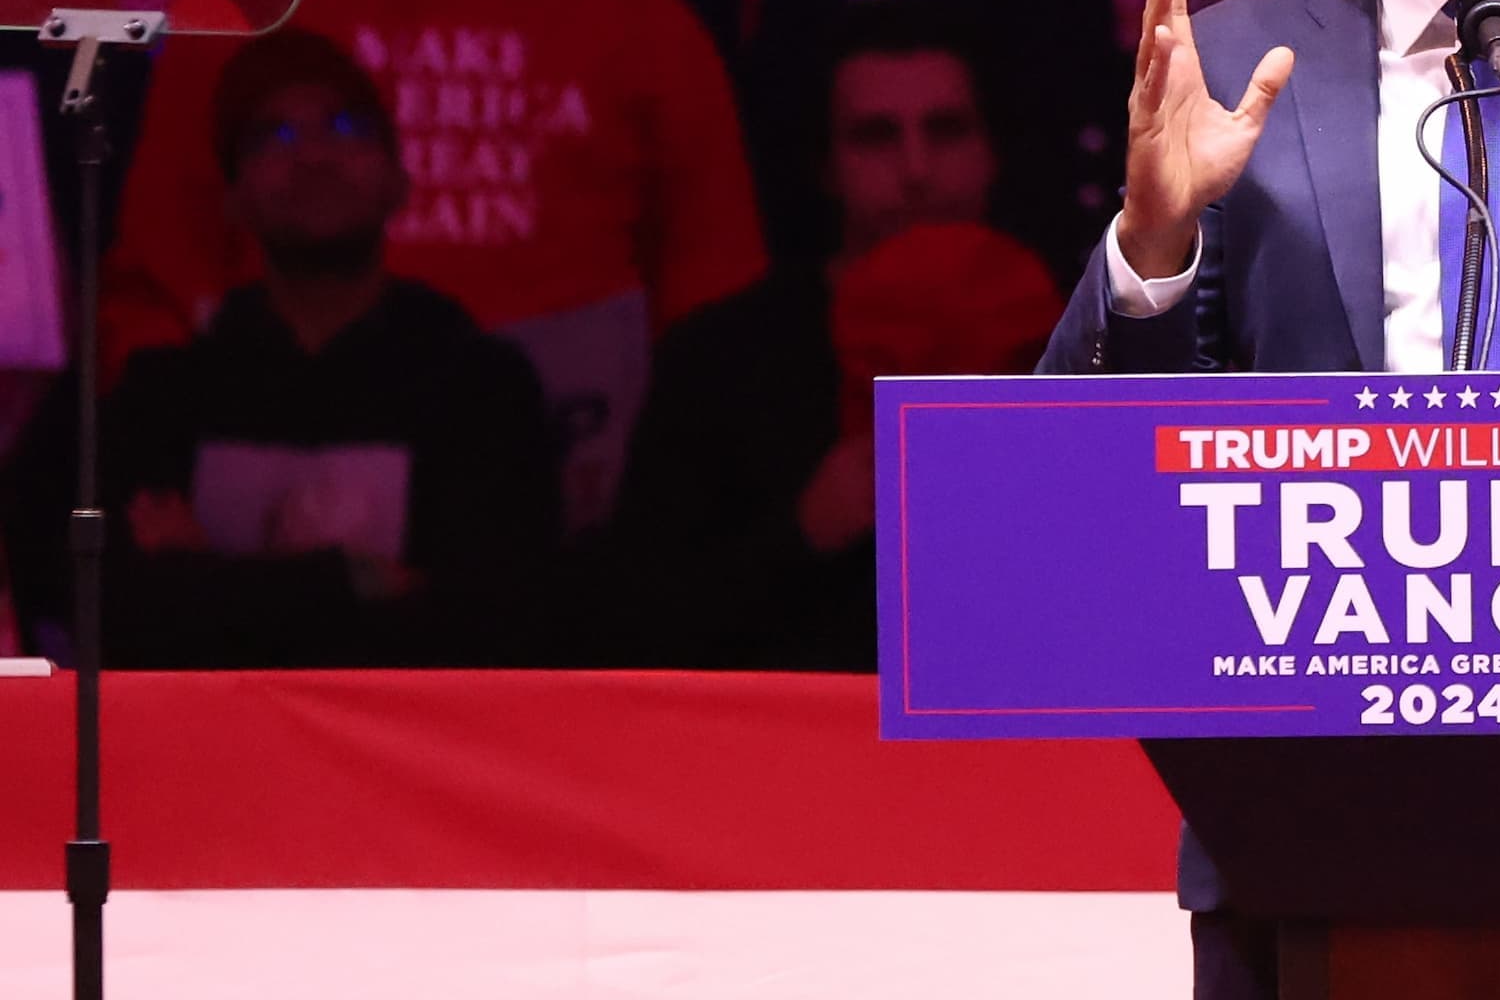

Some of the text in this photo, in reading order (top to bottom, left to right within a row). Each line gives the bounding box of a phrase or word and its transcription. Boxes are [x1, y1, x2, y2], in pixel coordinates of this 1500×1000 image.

[1178, 427, 1372, 470] TRUMP
[1212, 655, 1297, 677] MAKE
[1305, 654, 1442, 676] AMERICA
